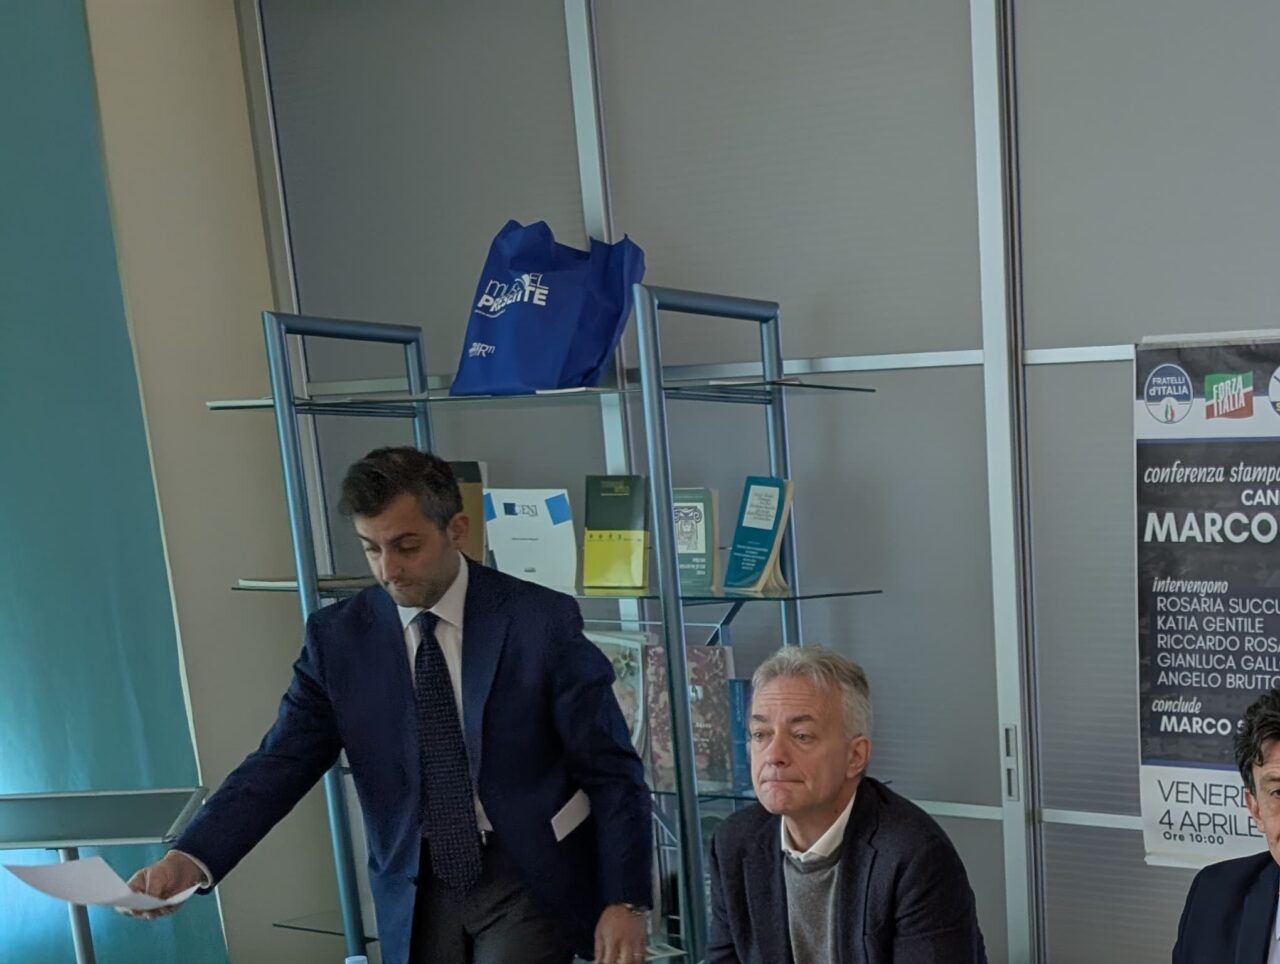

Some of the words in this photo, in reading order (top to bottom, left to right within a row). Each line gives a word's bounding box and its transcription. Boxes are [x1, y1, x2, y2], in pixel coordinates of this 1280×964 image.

[1152, 377, 1185, 385] FRATELLI
[1213, 376, 1243, 399] FORZA
[1150, 386, 1189, 396] d'ITALIA
[1213, 393, 1246, 417] ITALIA
[1144, 460, 1225, 483] conferenza
[1143, 512, 1278, 543] MARCO
[1152, 577, 1228, 596] intervengono
[1157, 597, 1224, 613] ROSARIA
[1157, 616, 1198, 631] KATIA
[1203, 617, 1264, 633] GENTILE
[1157, 635, 1240, 651] RICCARDO
[1157, 653, 1236, 670] GIANLUCA
[1157, 672, 1222, 688] ANGELO
[1152, 696, 1201, 714] conclude
[1160, 717, 1232, 735] MARCO
[1159, 809, 1174, 830] 4
[1180, 810, 1264, 838] APRILE
[1163, 831, 1185, 841] Ore
[1189, 833, 1225, 845] 10:00
